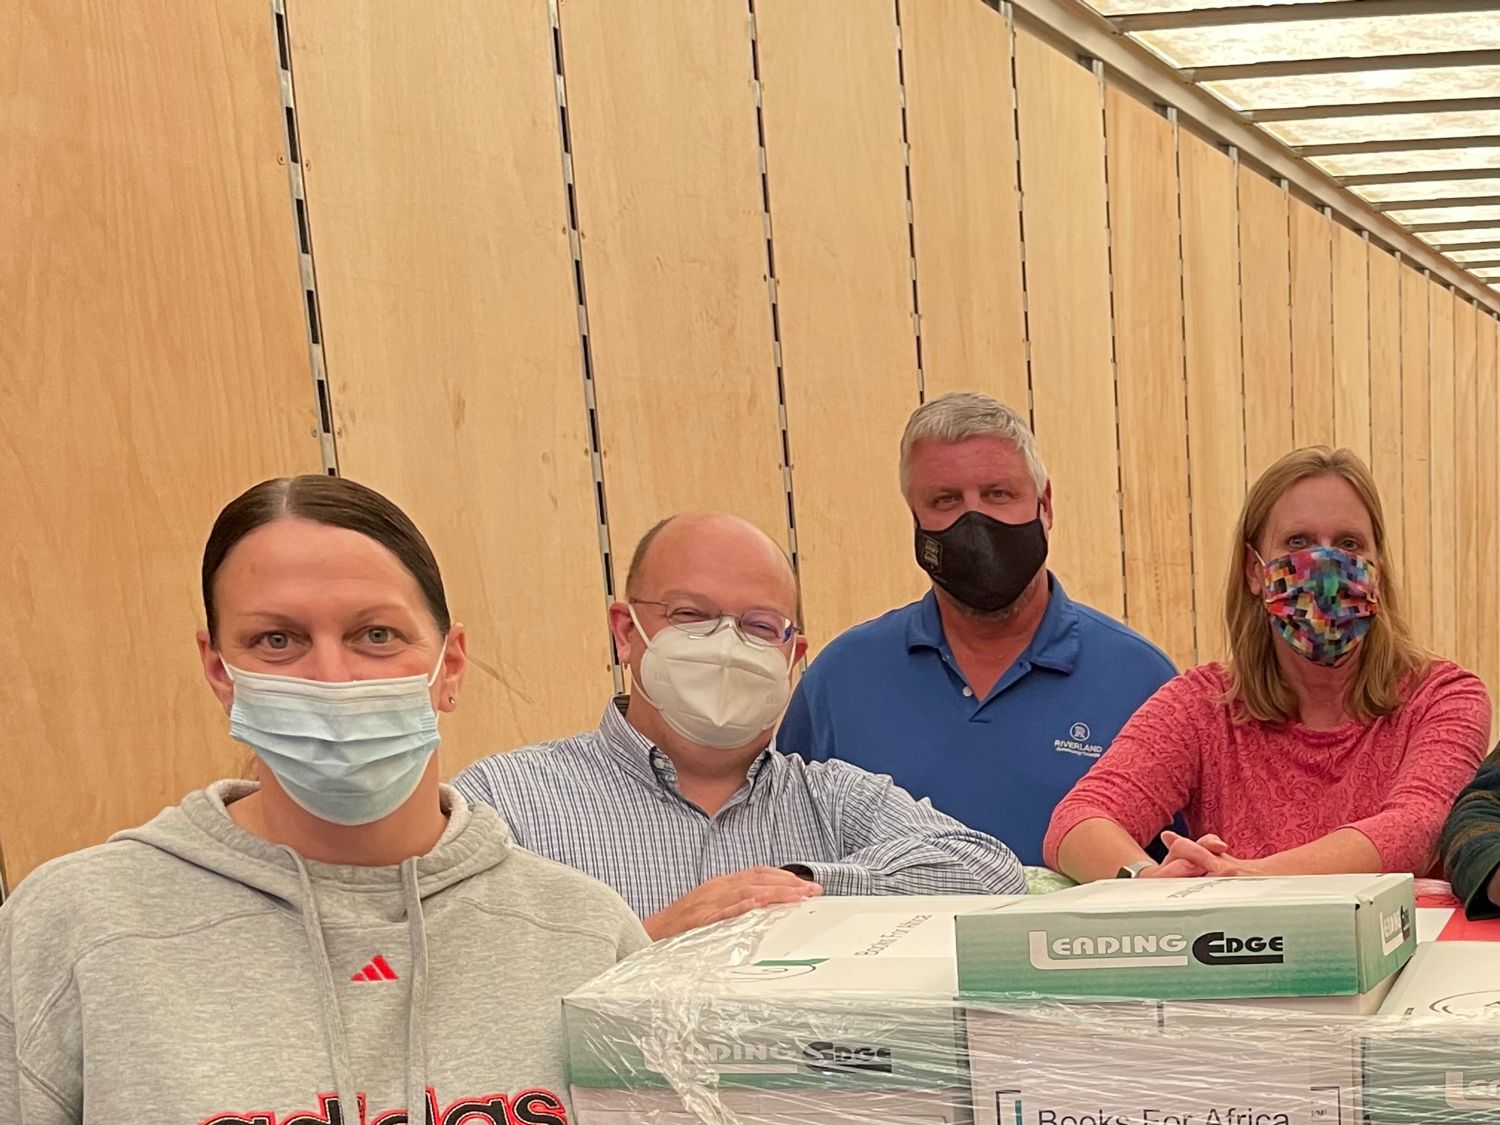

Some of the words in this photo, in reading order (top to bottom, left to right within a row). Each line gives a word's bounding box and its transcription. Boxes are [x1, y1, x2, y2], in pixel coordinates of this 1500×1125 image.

[1054, 740, 1103, 753] RIVERLAND
[1029, 930, 1189, 970] LEADING
[1191, 931, 1284, 966] EDGE
